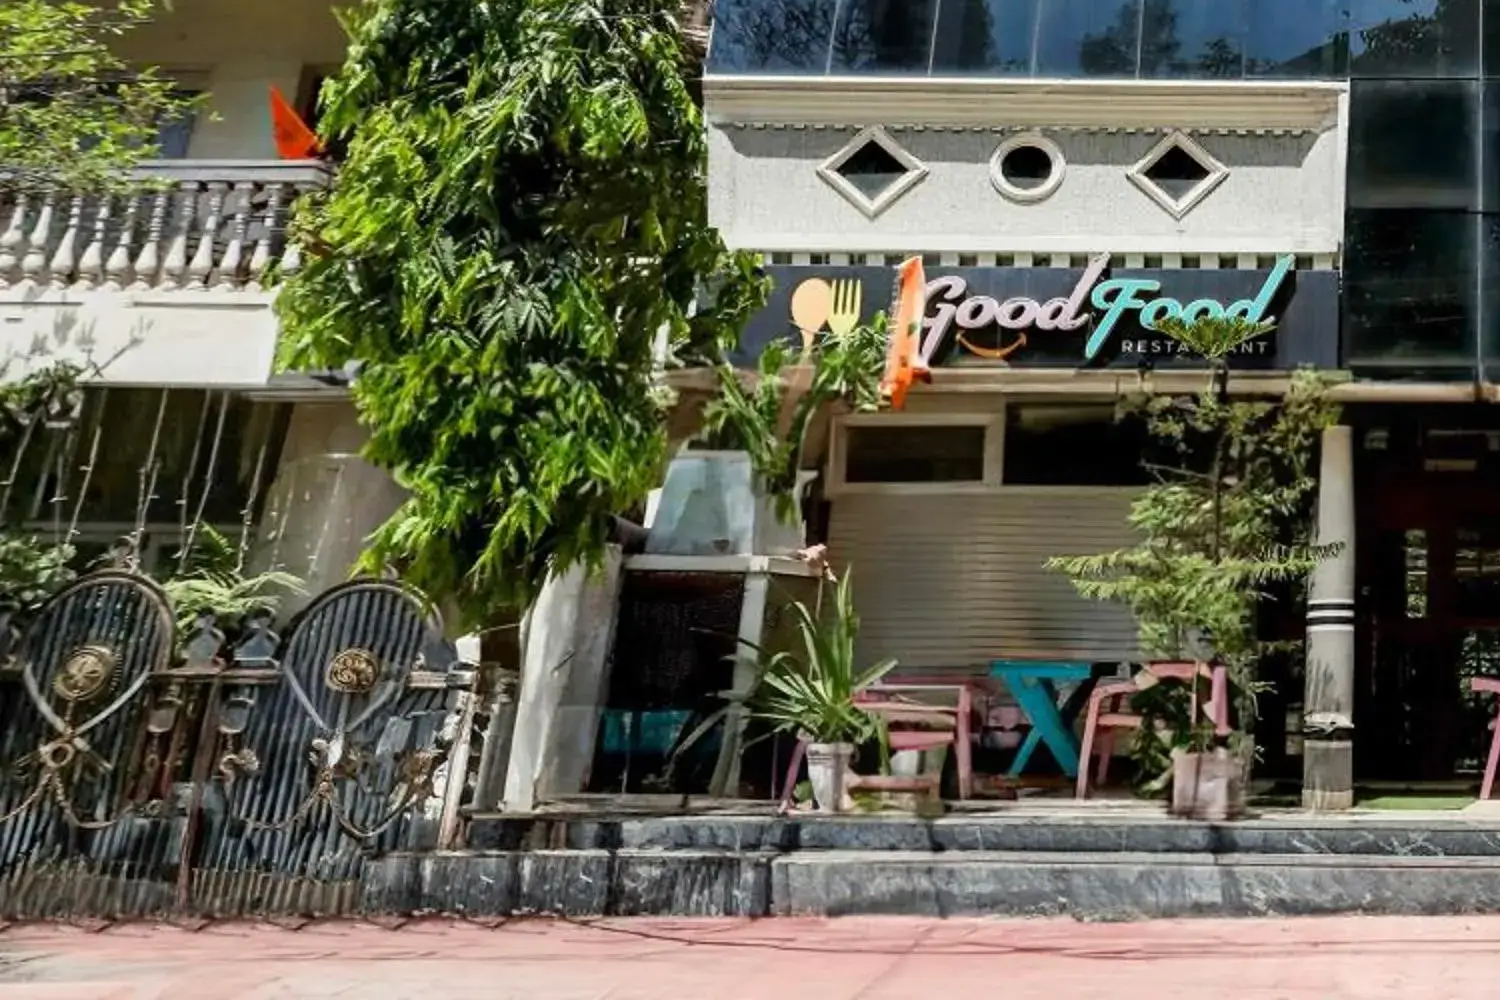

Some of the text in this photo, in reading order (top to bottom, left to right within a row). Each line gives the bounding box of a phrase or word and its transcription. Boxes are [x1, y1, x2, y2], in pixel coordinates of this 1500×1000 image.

[922, 251, 1295, 369] Good Food
[1121, 340, 1268, 354] RESTAANT
